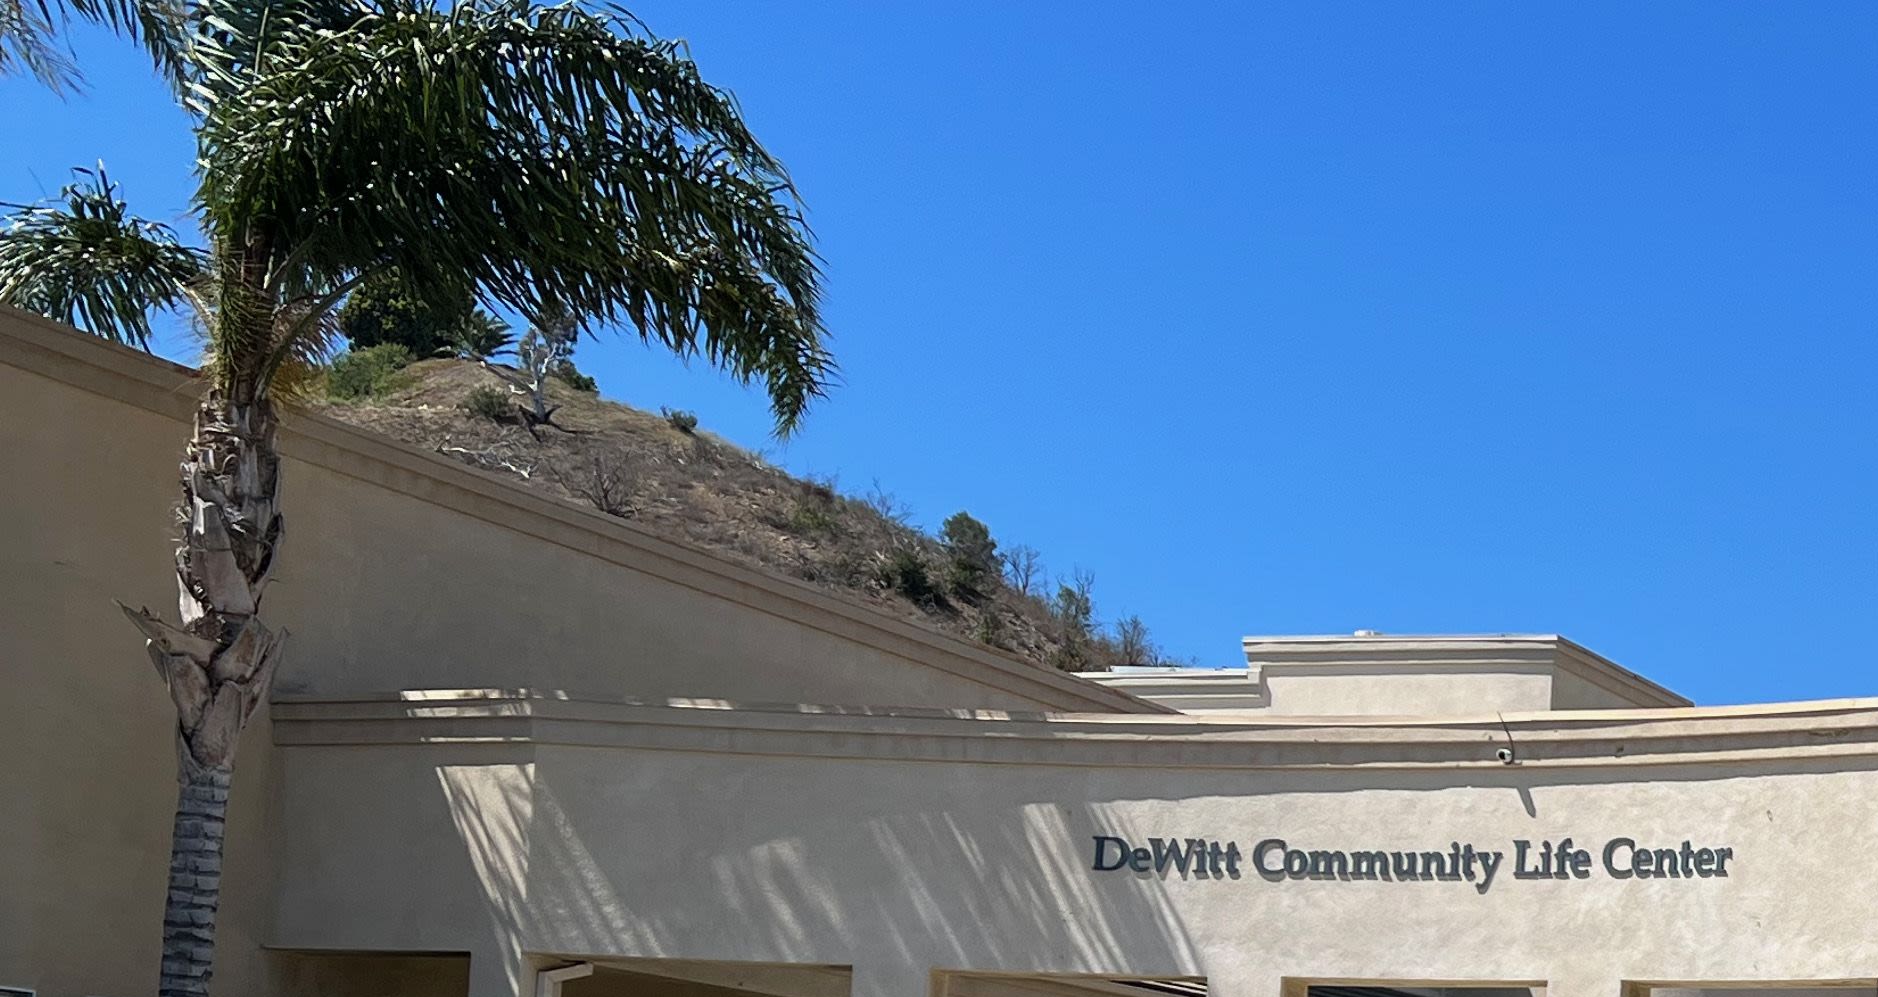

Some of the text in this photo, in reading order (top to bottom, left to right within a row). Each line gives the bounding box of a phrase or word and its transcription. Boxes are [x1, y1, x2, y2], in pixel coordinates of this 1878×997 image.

[1092, 835, 1733, 895] DeWitt Community Life Center
